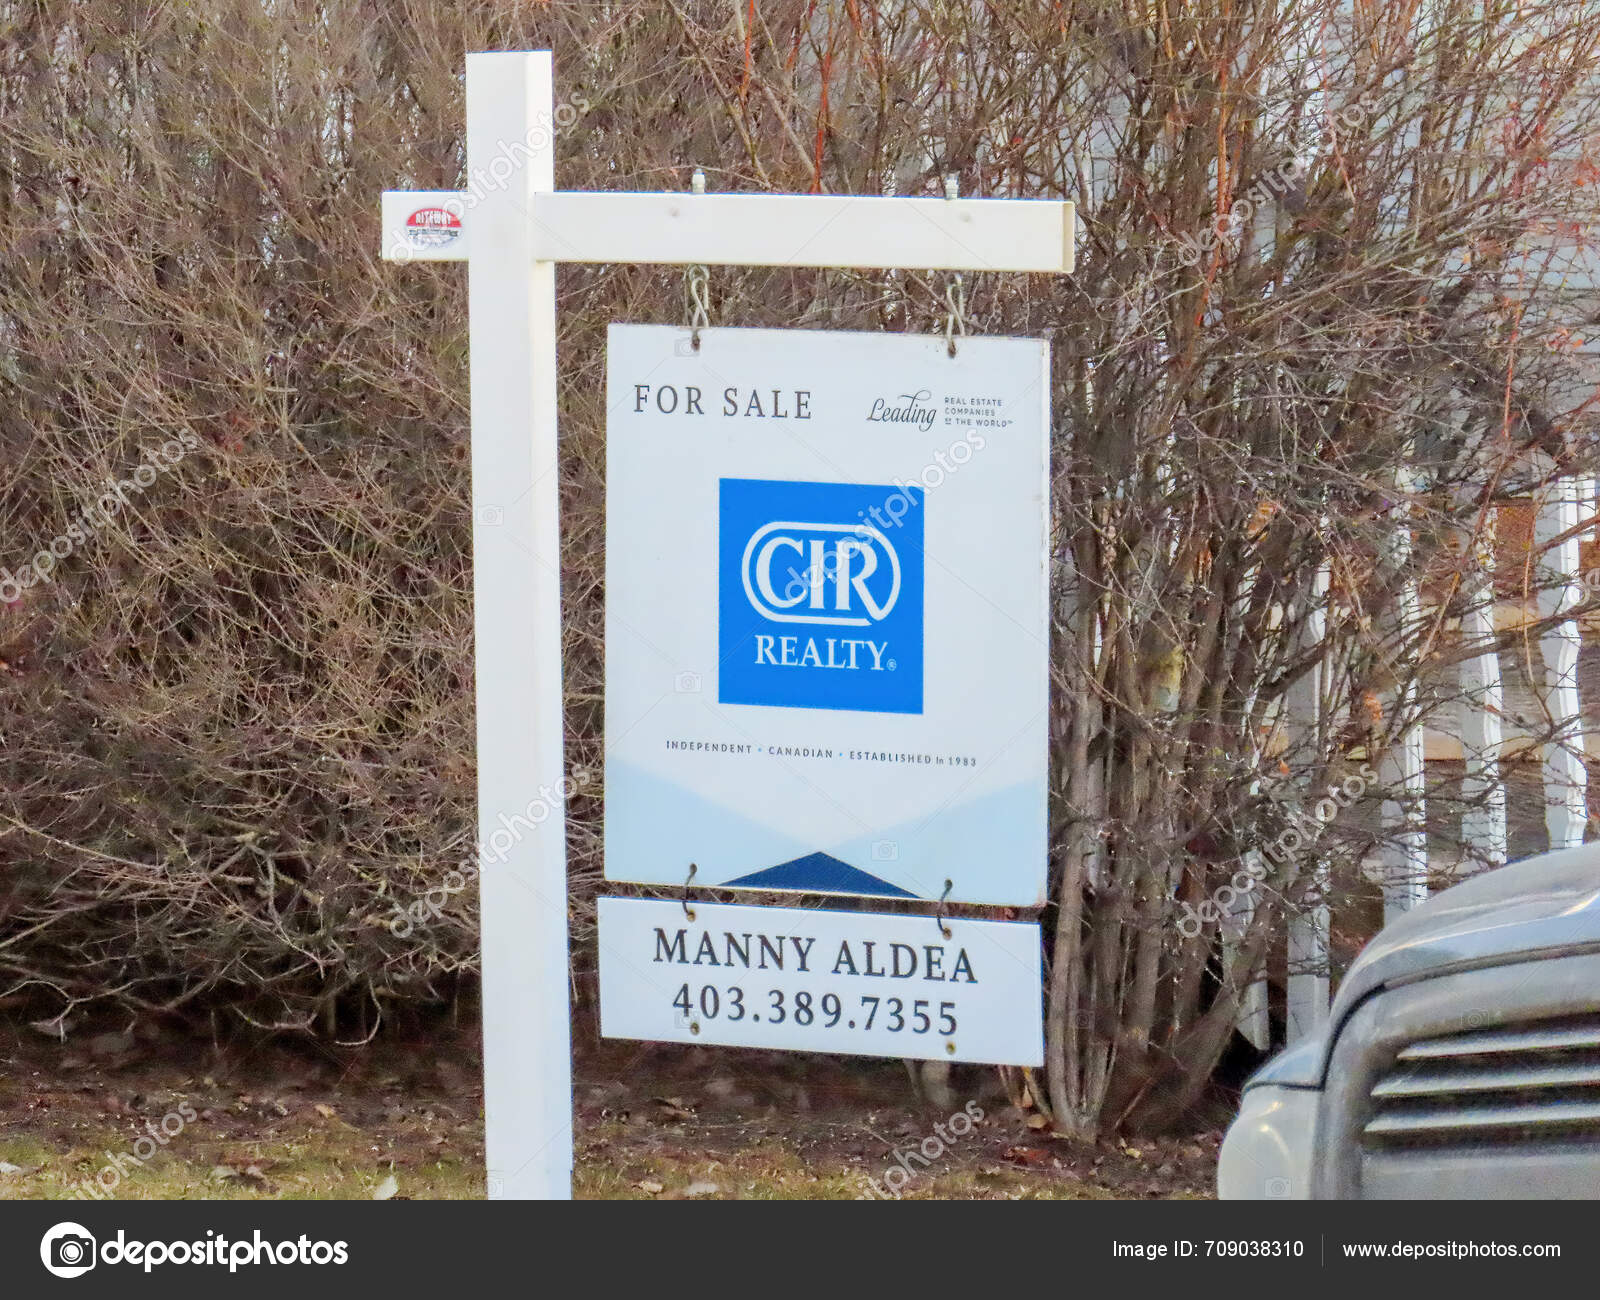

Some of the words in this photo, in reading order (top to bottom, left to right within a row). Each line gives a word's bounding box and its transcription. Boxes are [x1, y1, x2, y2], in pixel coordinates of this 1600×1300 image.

[633, 384, 705, 415] FOR
[723, 387, 811, 419] SALE
[866, 389, 937, 433] Leading
[944, 397, 967, 405] REAL
[970, 398, 1003, 407] ESTATE
[944, 407, 996, 417] COMPANIES
[955, 417, 972, 426] THE
[755, 536, 884, 621] CIR
[666, 740, 752, 755] INDEPENDENT
[768, 746, 833, 759] CANADIAN
[849, 751, 932, 765] ESTABLISHED
[948, 757, 977, 768] 1983
[653, 927, 817, 972] MANNY
[831, 940, 979, 985] ALDEA
[672, 983, 958, 1037] 403.389.7355
